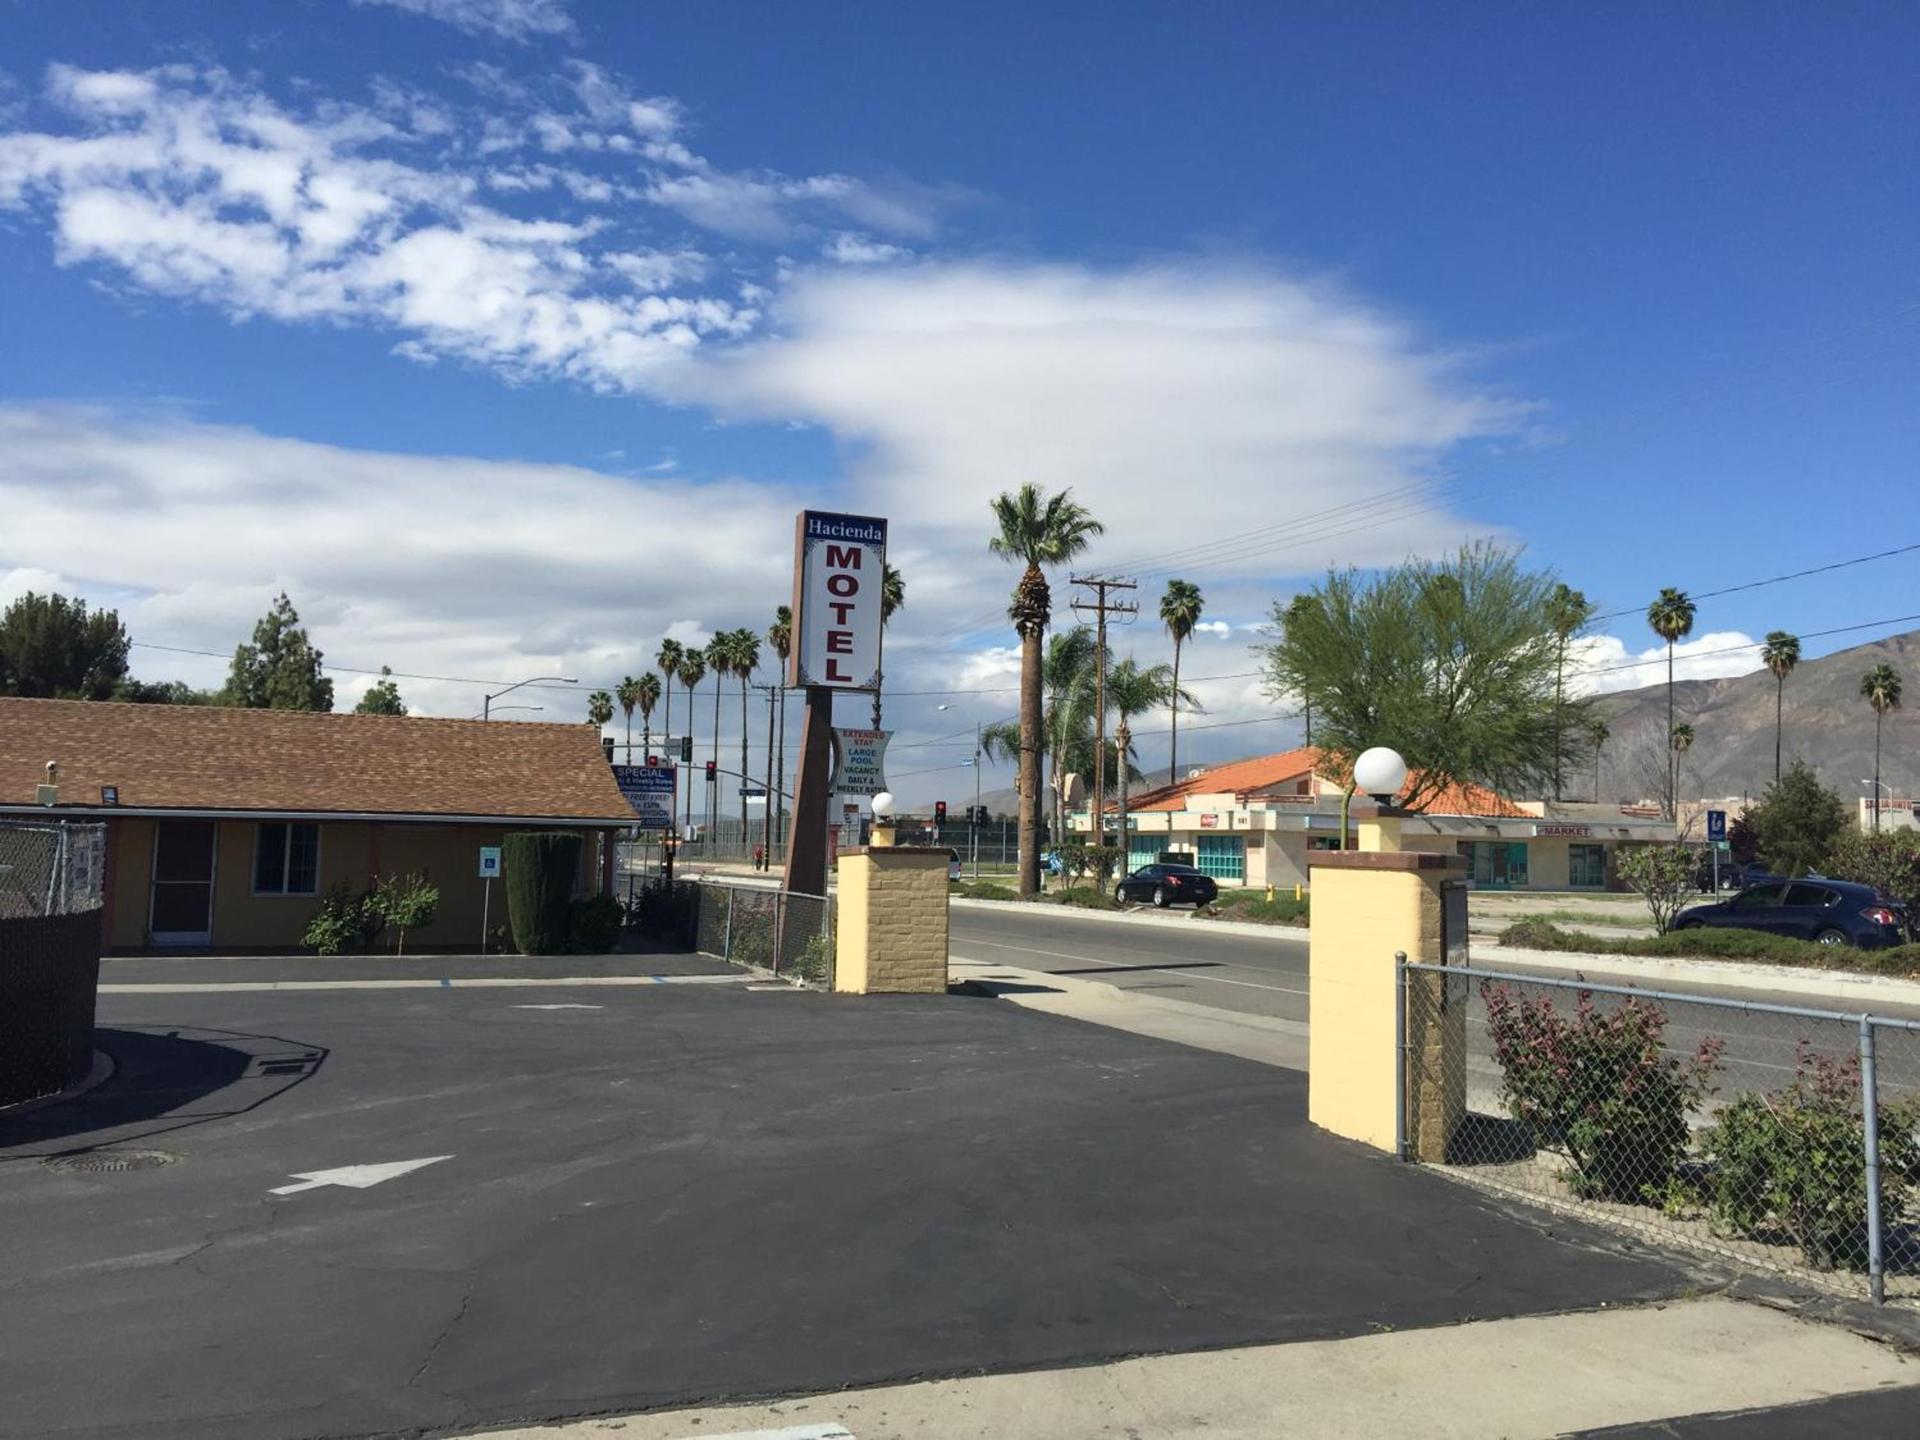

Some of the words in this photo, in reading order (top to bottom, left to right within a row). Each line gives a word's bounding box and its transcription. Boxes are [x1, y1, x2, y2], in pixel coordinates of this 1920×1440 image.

[808, 519, 882, 540] Hacienda
[825, 544, 862, 682] MOTEL
[843, 730, 886, 740] EXTENDED
[848, 748, 877, 757] LARGE
[850, 756, 873, 765] POOL
[618, 768, 665, 778] SPECIAL
[844, 766, 880, 775] VACANCY
[848, 775, 868, 784] DAILY
[837, 784, 863, 792] WEEKLY
[1545, 827, 1589, 836] MARKET
